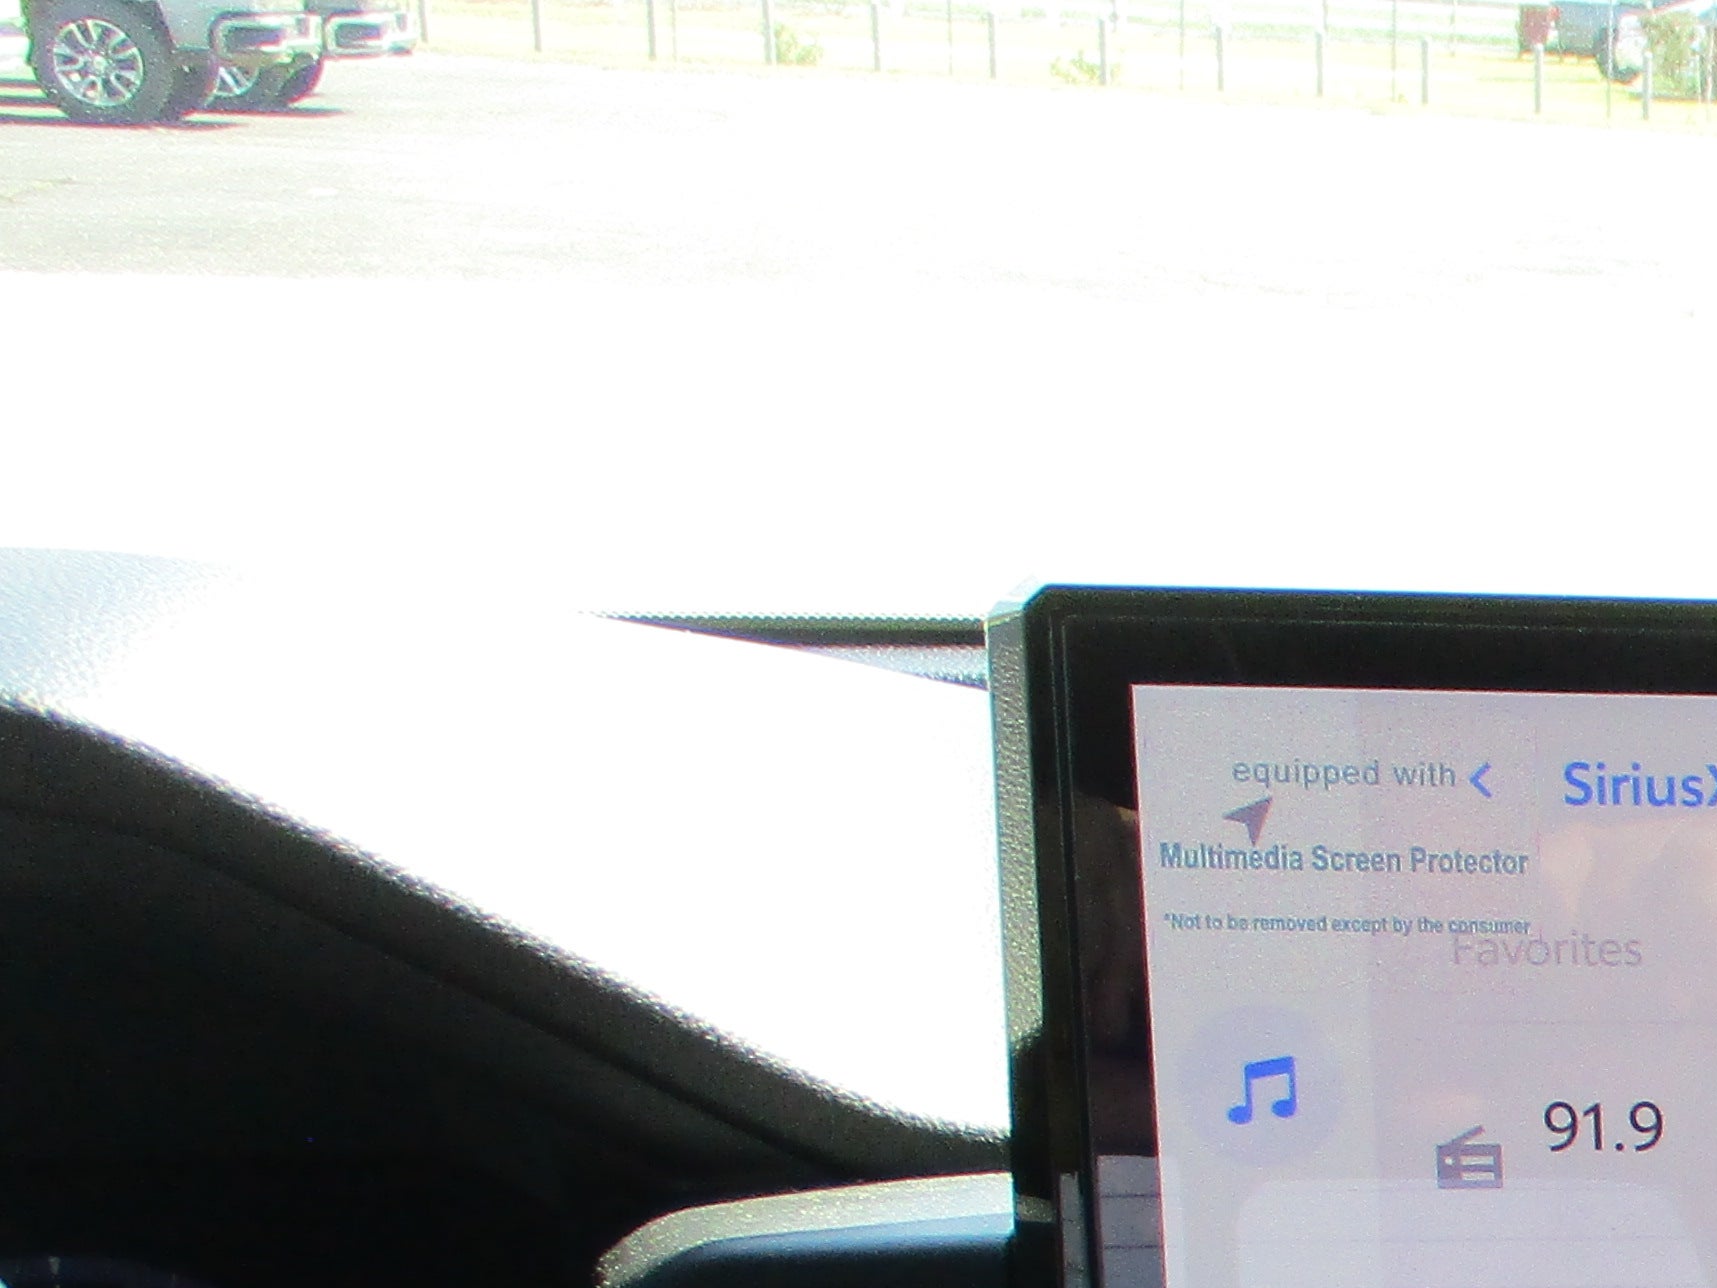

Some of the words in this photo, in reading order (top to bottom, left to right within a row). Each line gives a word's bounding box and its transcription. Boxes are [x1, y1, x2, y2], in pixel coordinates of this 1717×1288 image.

[1231, 760, 1379, 790] equipped
[1392, 761, 1456, 787] with
[1160, 842, 1304, 872] Multimedia
[1312, 845, 1402, 872] Screen
[1410, 847, 1530, 875] Protector
[1205, 915, 1223, 930] to
[1227, 914, 1249, 931] be
[1252, 915, 1328, 932] removed
[1331, 918, 1389, 936] except
[1392, 917, 1414, 936] by
[1418, 918, 1443, 933] the
[1448, 919, 1531, 935] consumer
[1453, 928, 1644, 967] Favorites
[1543, 1100, 1665, 1154] 91.9
